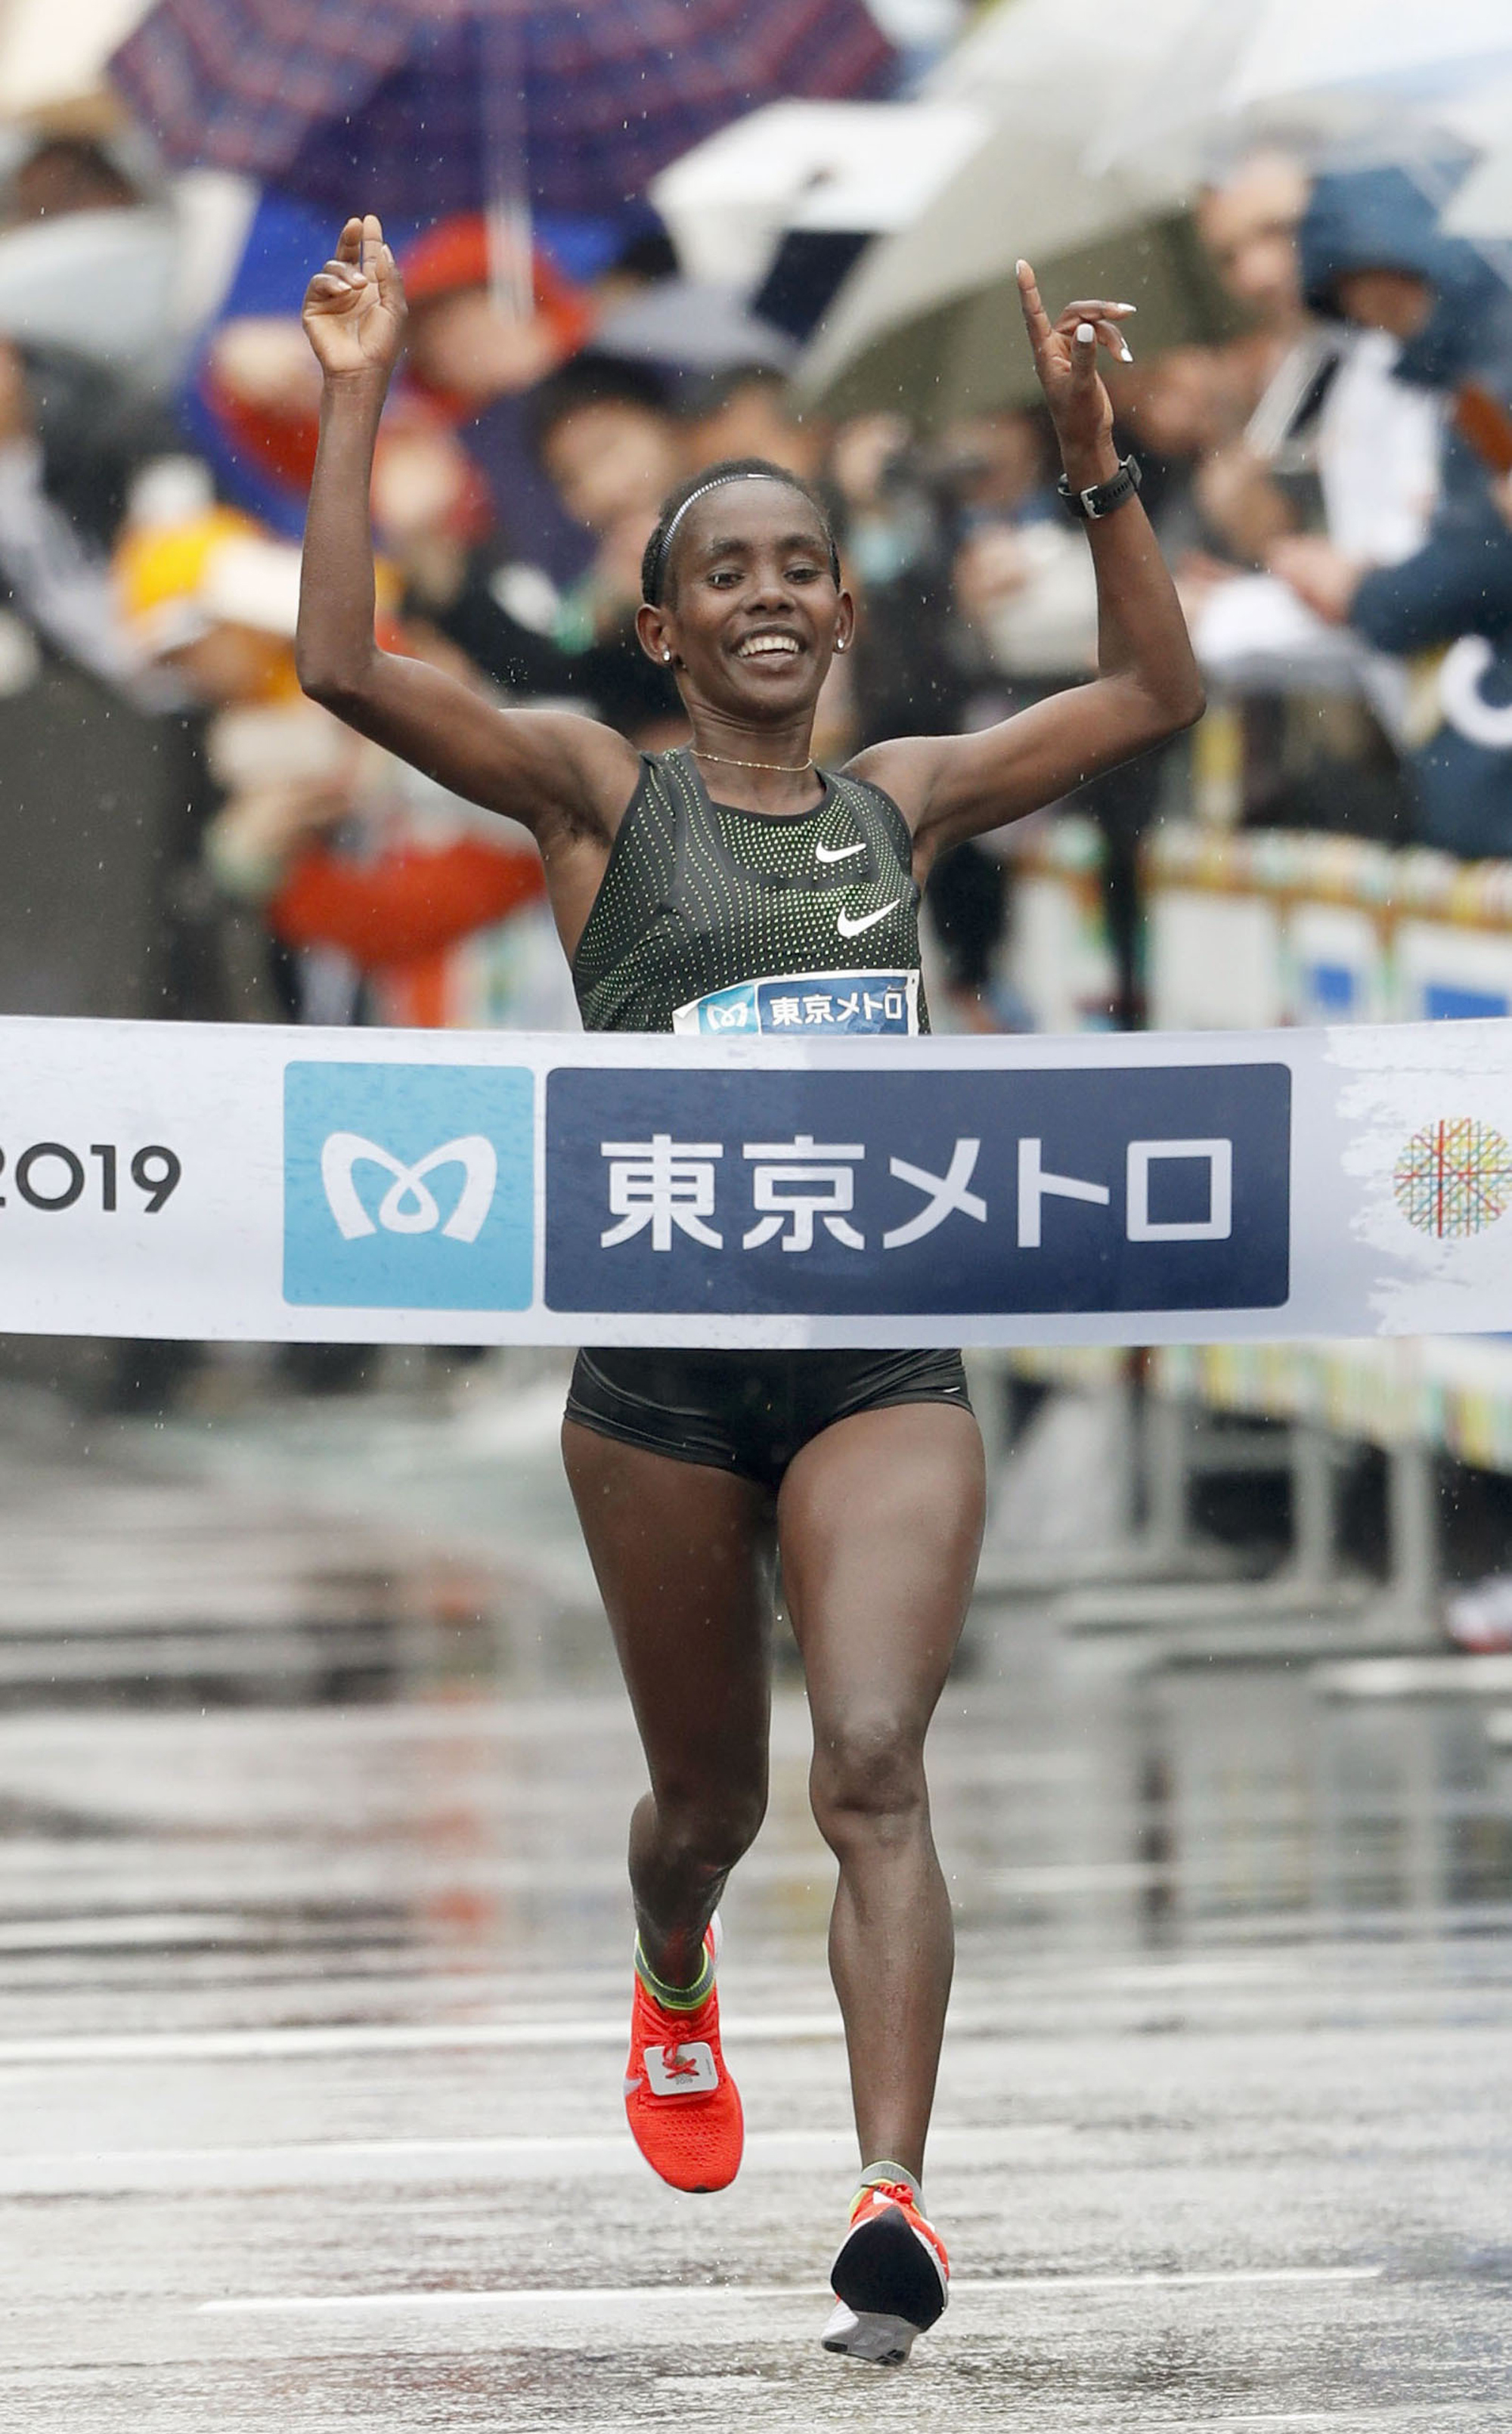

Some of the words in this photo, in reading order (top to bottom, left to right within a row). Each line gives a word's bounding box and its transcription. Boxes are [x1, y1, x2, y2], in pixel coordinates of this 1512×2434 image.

[769, 991, 903, 1026] 東京メトロ
[0, 1142, 181, 1214] 019
[600, 1133, 1232, 1252] 東京メトロ
